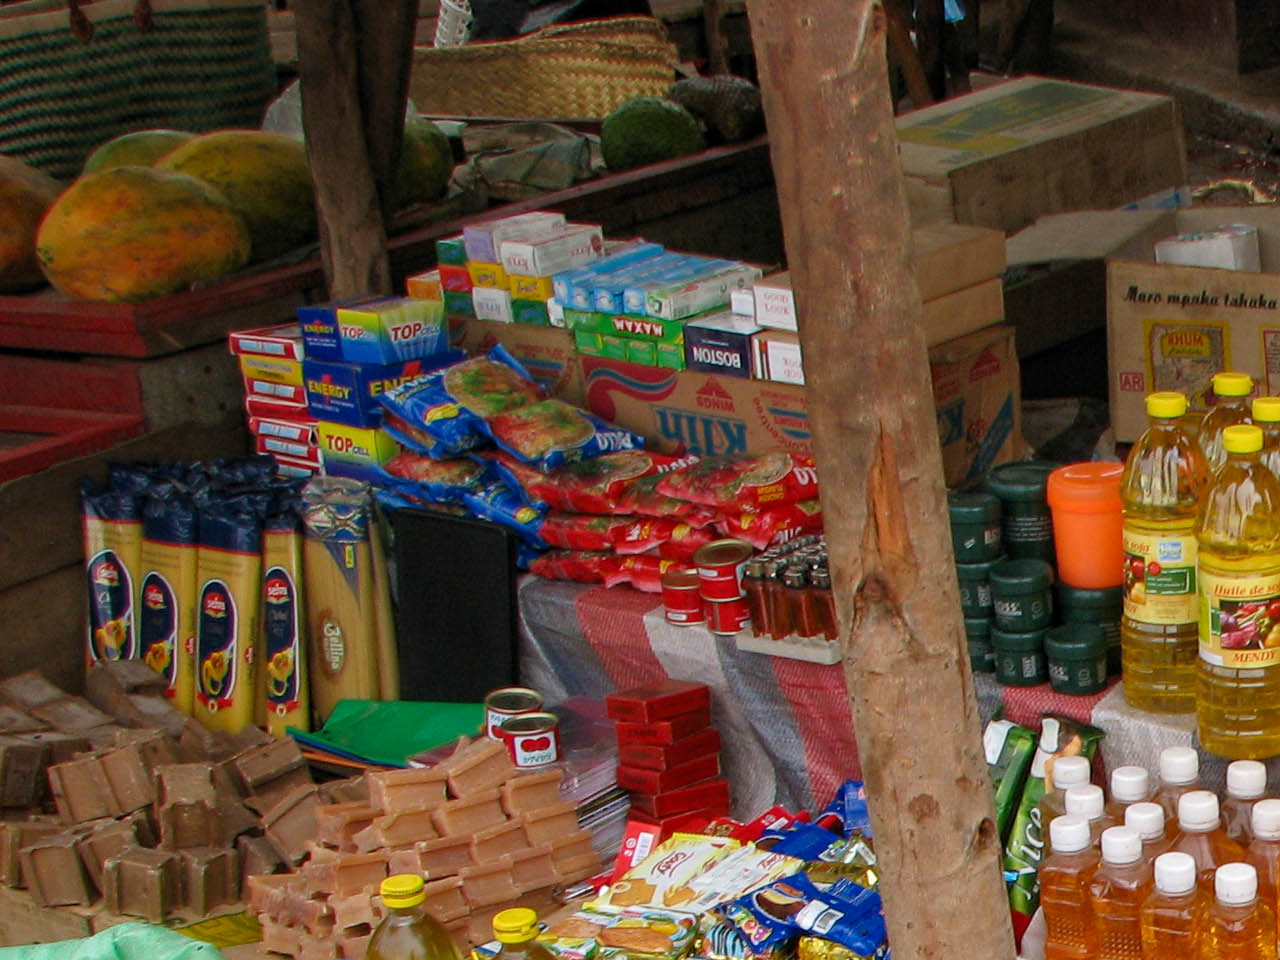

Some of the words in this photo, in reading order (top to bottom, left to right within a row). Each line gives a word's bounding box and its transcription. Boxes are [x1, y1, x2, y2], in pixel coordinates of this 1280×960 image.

[1167, 291, 1219, 307] mpaka
[341, 326, 364, 338] TOP
[391, 322, 422, 341] TOP
[612, 318, 664, 337] MAXAM
[692, 346, 742, 369] BOSTON
[307, 380, 351, 399] ENERGY
[696, 396, 736, 413] WINGS
[655, 406, 748, 456] Klin
[326, 434, 353, 452] TOP
[352, 445, 370, 456] CELL
[1213, 583, 1246, 597] Huile
[1250, 583, 1265, 595] de
[1233, 650, 1277, 663] MENDY
